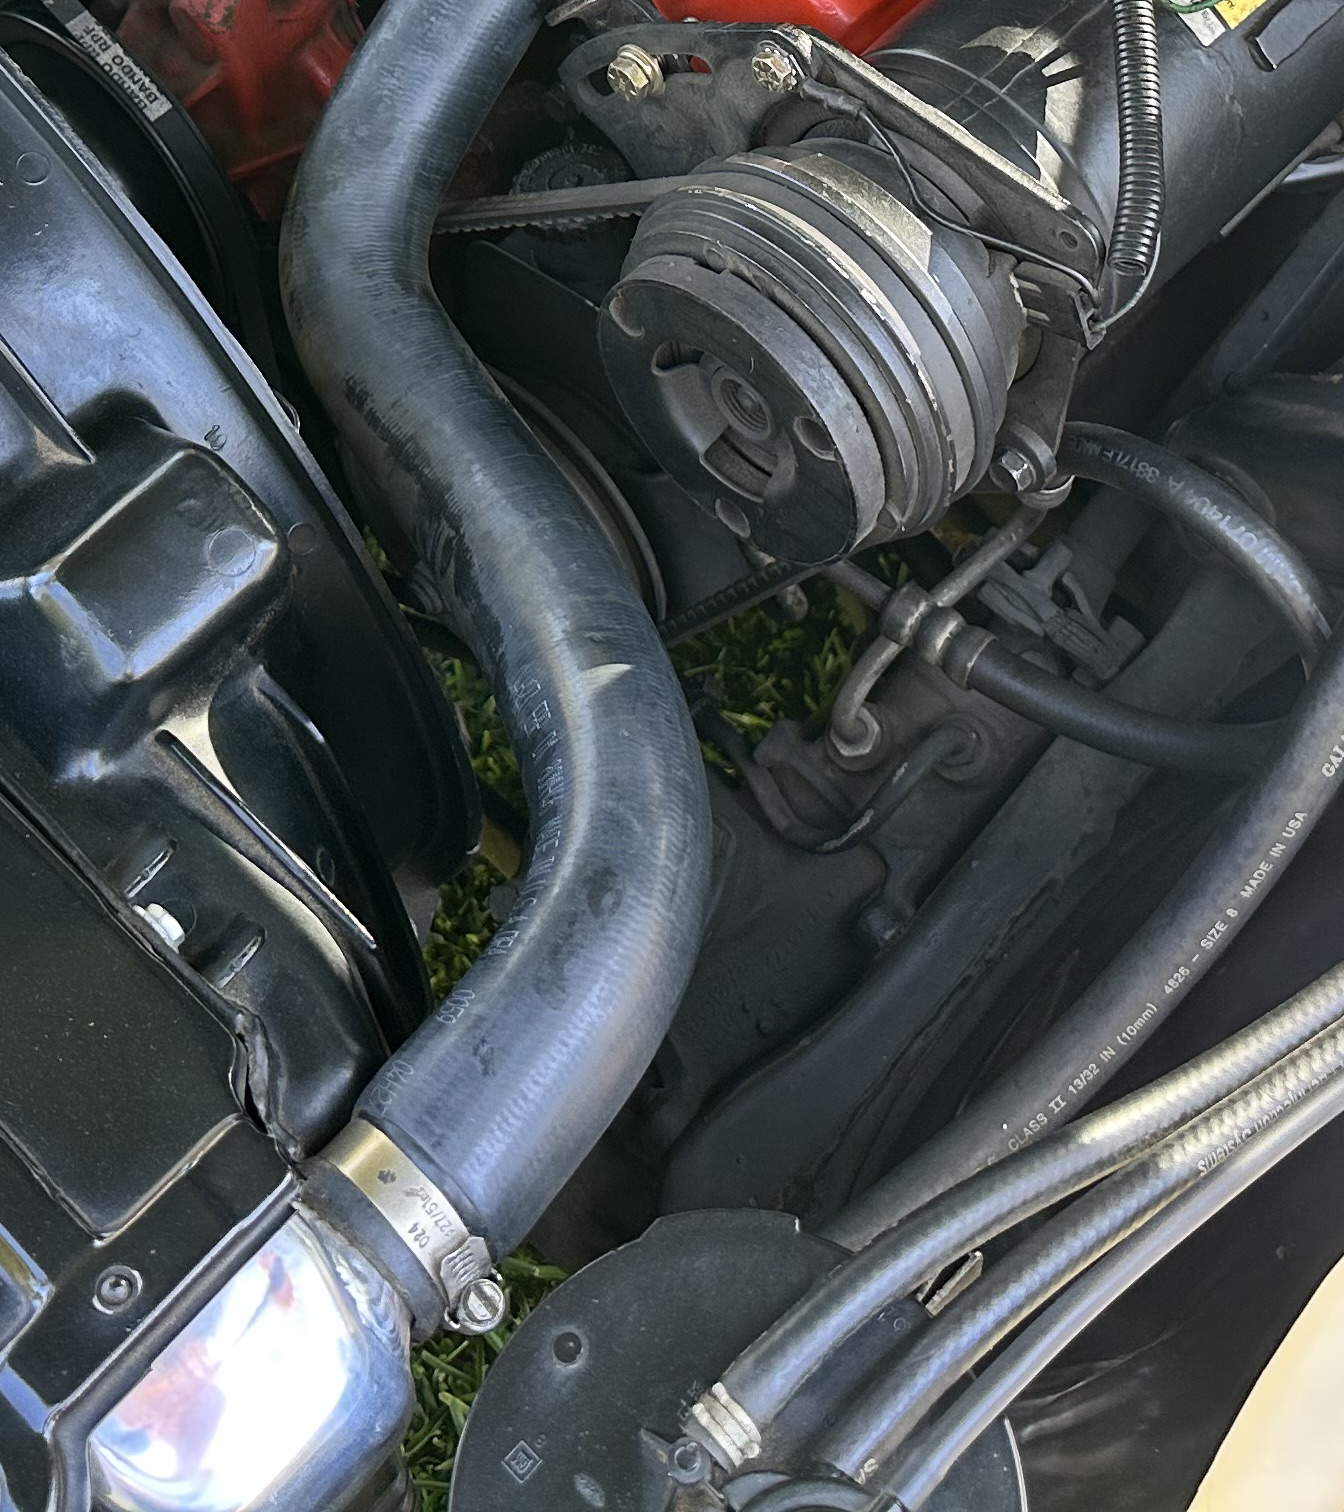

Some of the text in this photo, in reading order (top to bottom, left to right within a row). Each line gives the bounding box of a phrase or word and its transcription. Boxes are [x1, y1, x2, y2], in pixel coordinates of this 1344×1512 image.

[108, 51, 159, 105] BANDO
[1007, 1111, 1048, 1151] CLASS
[1067, 1062, 1100, 1097] 13/32
[1099, 1045, 1117, 1064] IN
[1117, 1001, 1159, 1047] (10mm)
[1200, 920, 1229, 950] SIZE
[1240, 860, 1274, 899] MADE
[1269, 842, 1286, 860] IN
[1282, 810, 1308, 839] USA
